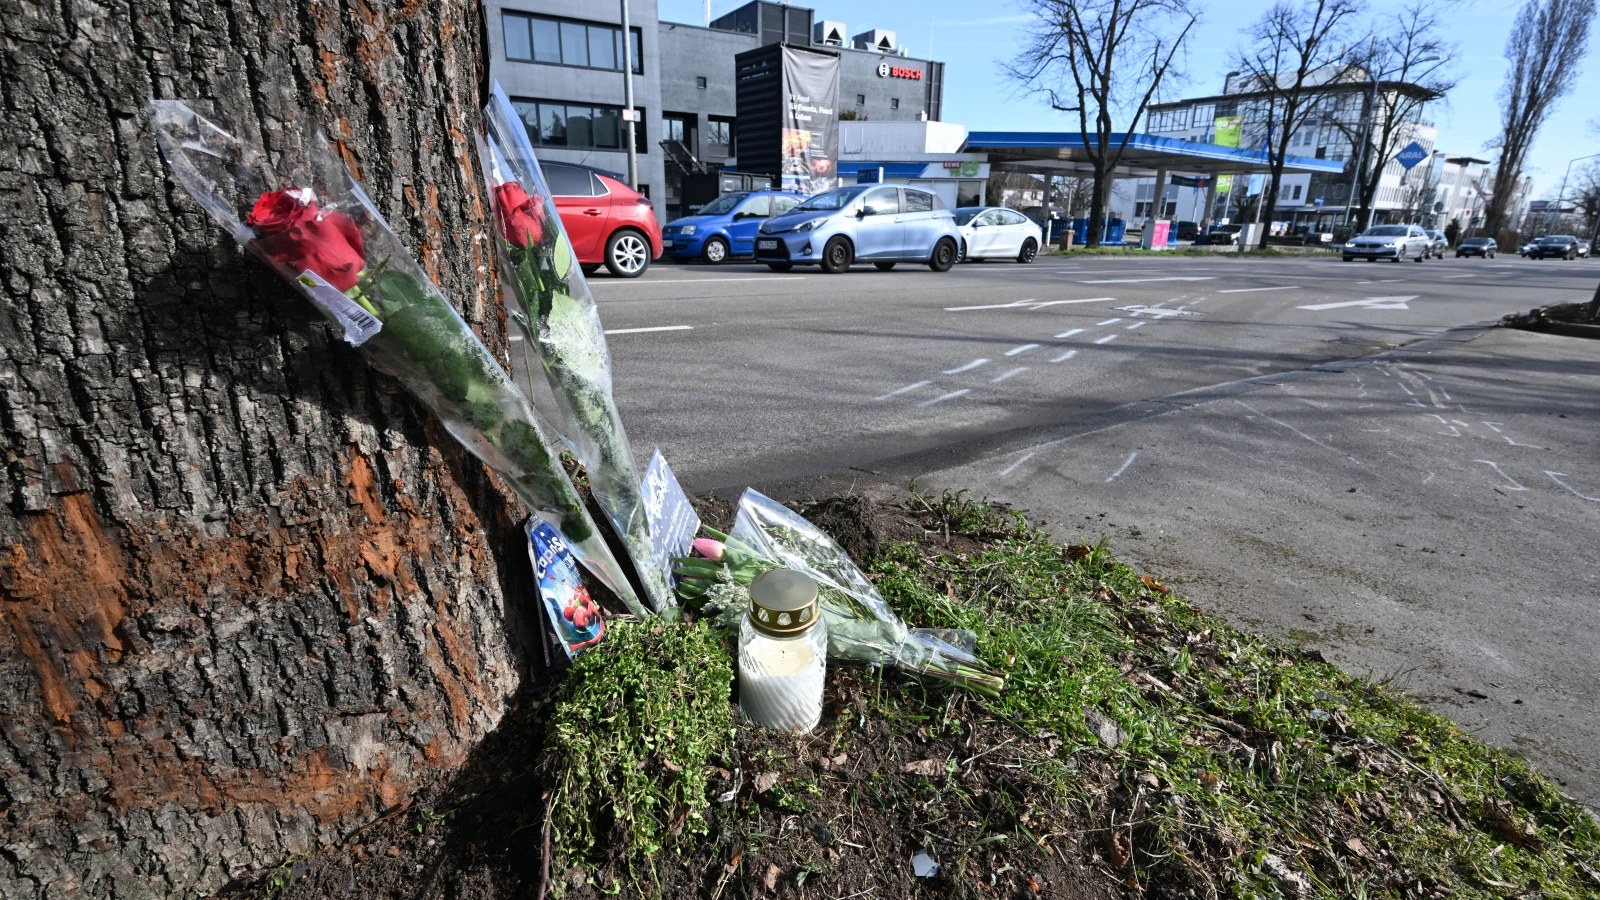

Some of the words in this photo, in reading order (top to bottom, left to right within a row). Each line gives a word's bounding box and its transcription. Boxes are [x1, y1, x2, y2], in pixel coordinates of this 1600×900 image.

[892, 66, 923, 79] BOSCH
[798, 103, 818, 114] Events,
[818, 106, 833, 115] Food
[1398, 151, 1423, 160] ARAL
